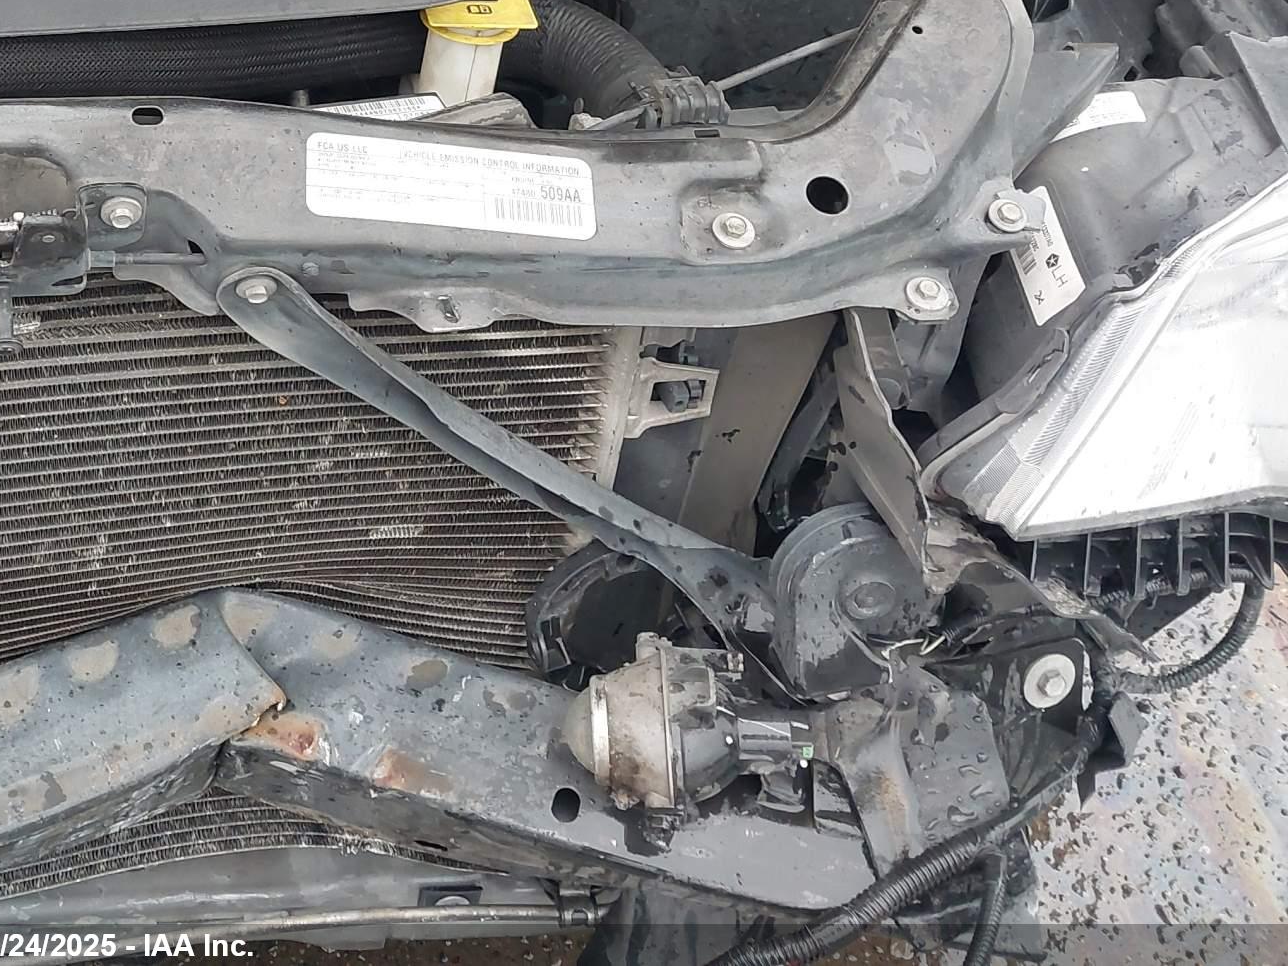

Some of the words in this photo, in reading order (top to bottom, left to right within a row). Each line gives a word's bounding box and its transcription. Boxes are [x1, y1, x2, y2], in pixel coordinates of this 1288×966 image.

[317, 141, 334, 150] FCA
[337, 143, 350, 153] US
[522, 162, 580, 177] INFORMATION
[540, 185, 582, 203] 509AA
[1052, 264, 1069, 288] LH
